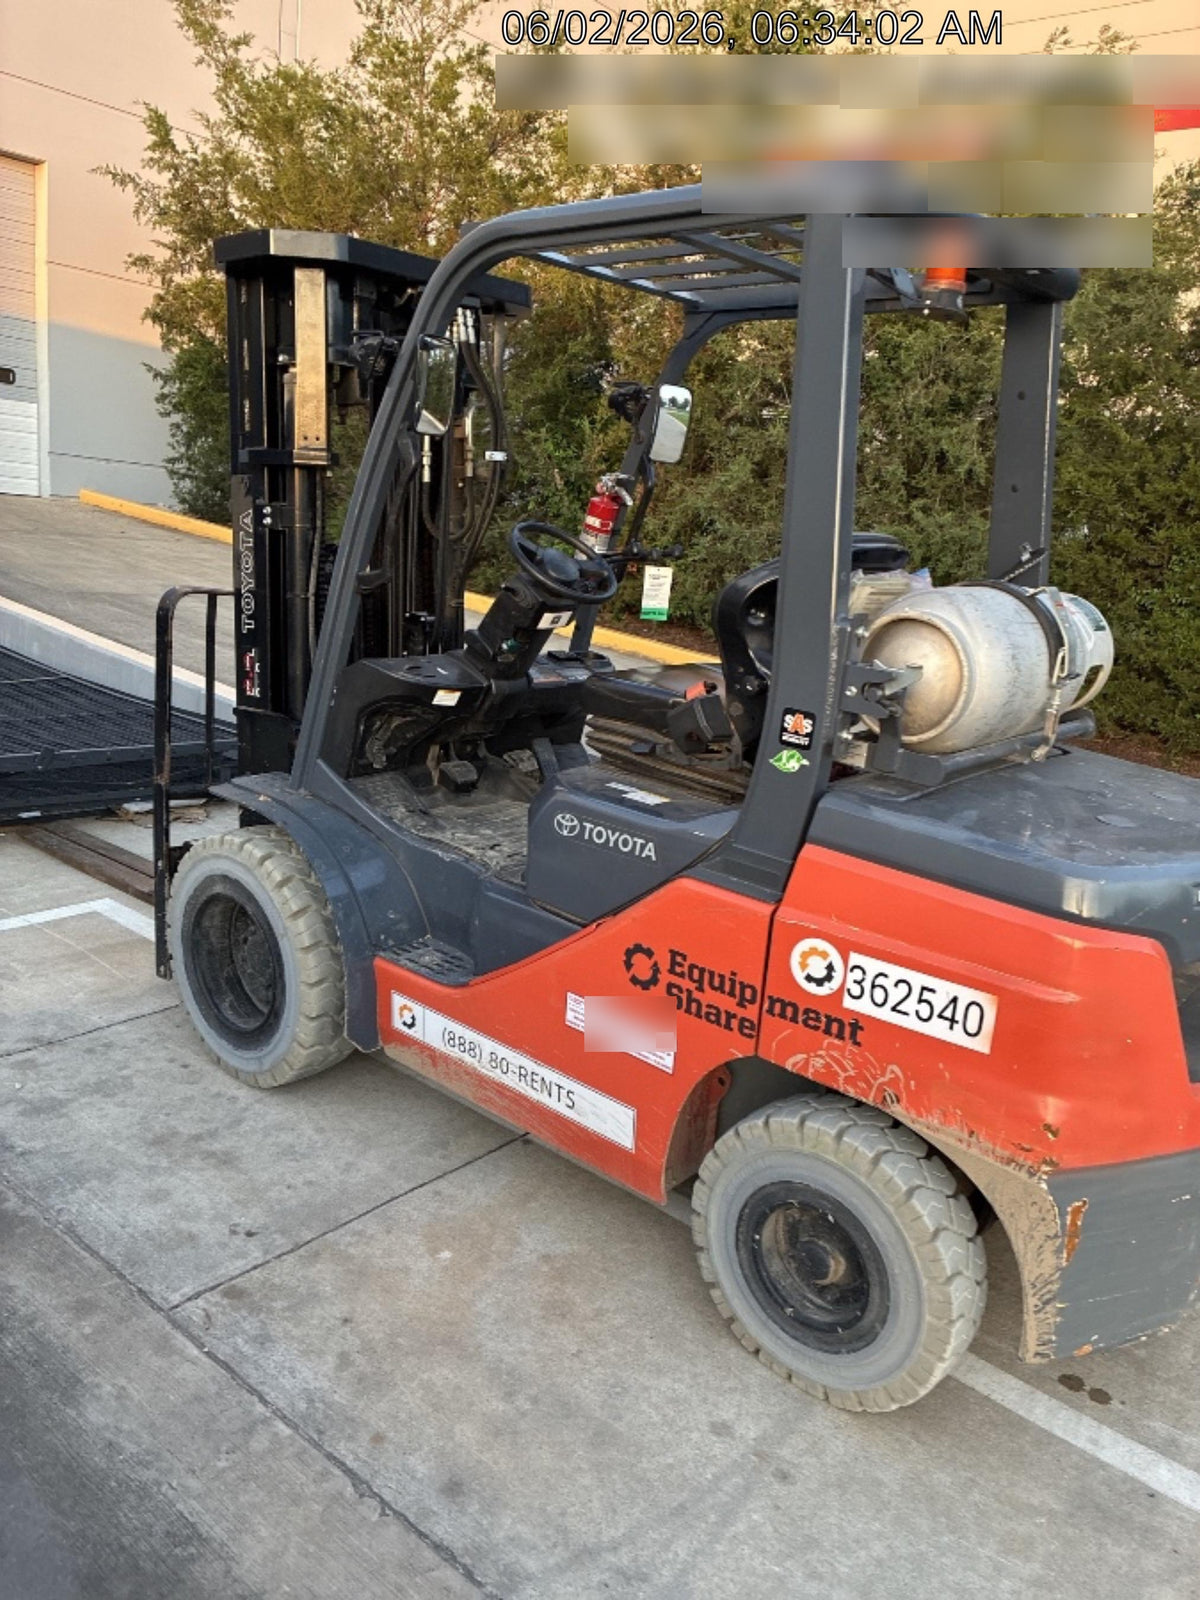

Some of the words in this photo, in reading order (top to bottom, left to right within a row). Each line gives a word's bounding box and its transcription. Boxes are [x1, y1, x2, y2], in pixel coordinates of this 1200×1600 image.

[239, 508, 256, 634] TOYOTA
[783, 713, 813, 735] SAS
[583, 821, 657, 861] TOYOTA
[846, 964, 985, 1038] 362540
[441, 1026, 483, 1063] (888)
[488, 1051, 576, 1111] 80-RENTS
